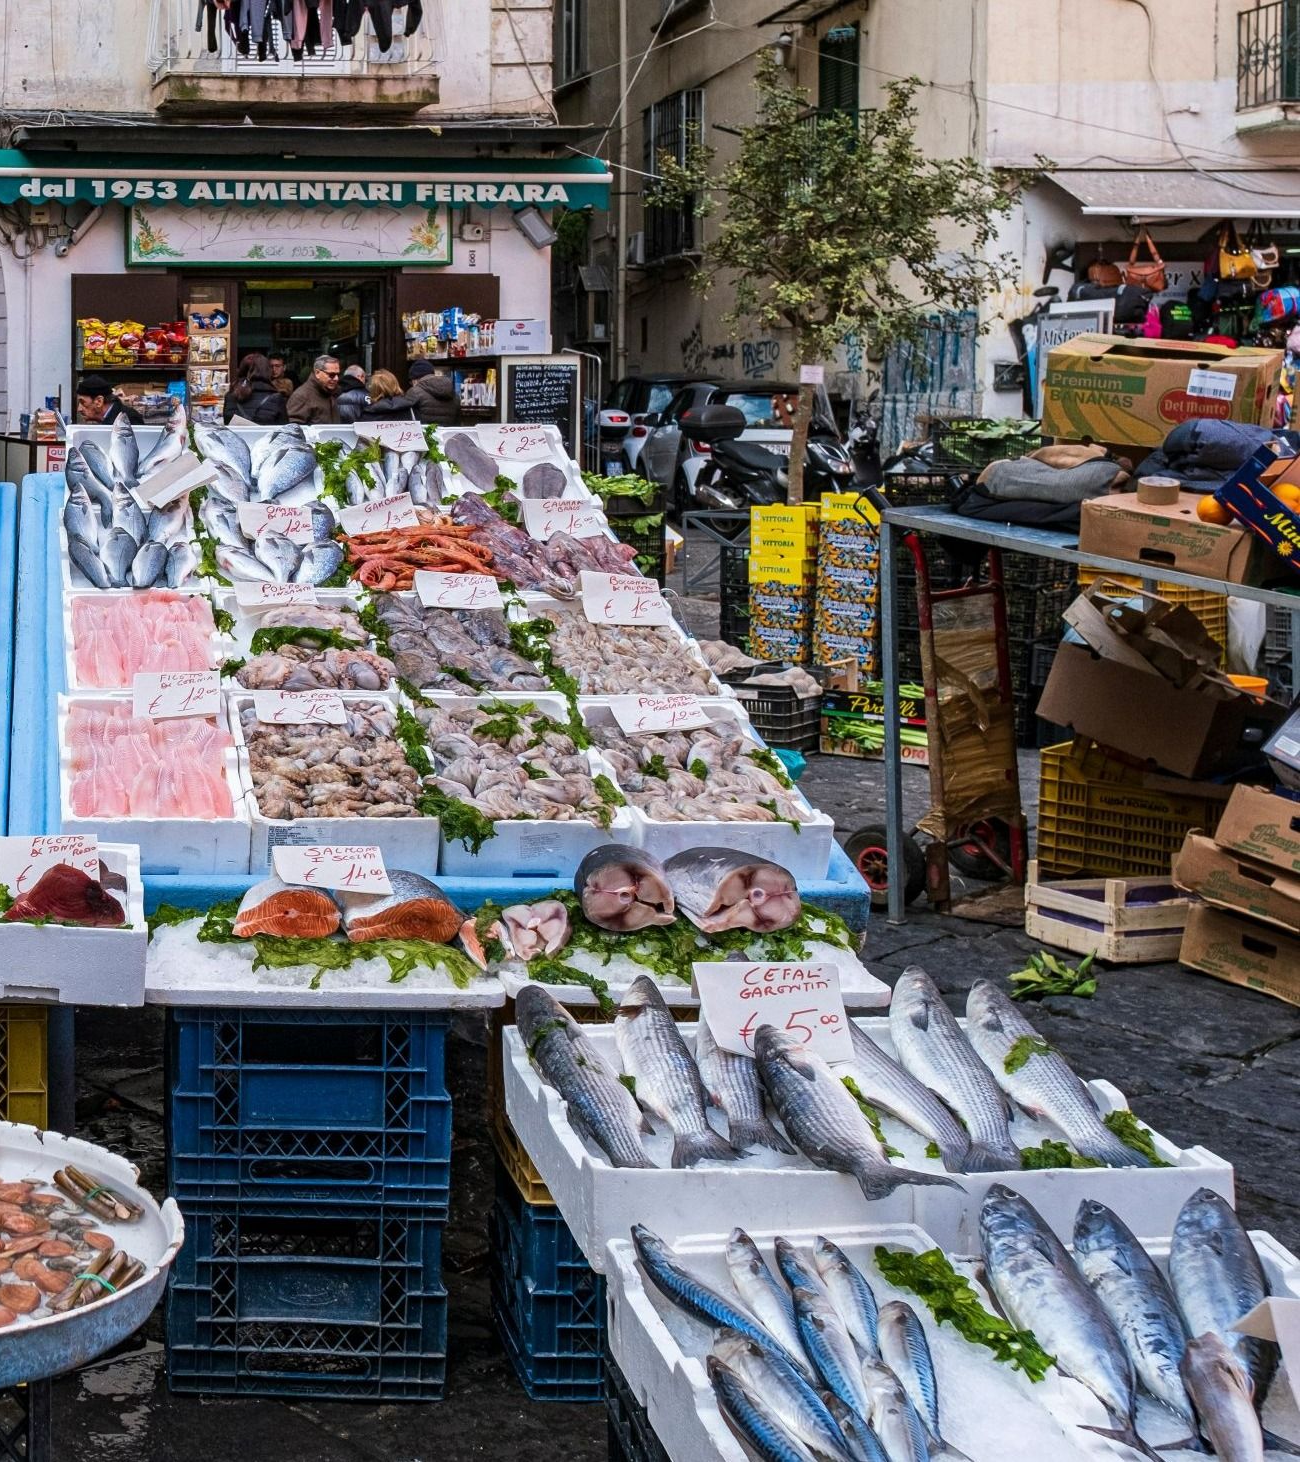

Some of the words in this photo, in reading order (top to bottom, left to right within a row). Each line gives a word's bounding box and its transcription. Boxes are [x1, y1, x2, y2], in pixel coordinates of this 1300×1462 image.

[19, 178, 76, 198] dal
[91, 180, 178, 199] 1953
[188, 181, 402, 201] ALIMENTARI
[415, 184, 569, 202] FERRARA
[1051, 373, 1123, 391] Premium
[1050, 389, 1134, 409] BANANAS
[1164, 400, 1180, 411] Del
[1182, 401, 1227, 415] Monte
[832, 502, 868, 512] VITTOIA
[762, 515, 794, 523] VITTORIA
[762, 539, 795, 548] VITTORIA
[759, 565, 791, 575] VITTORIA
